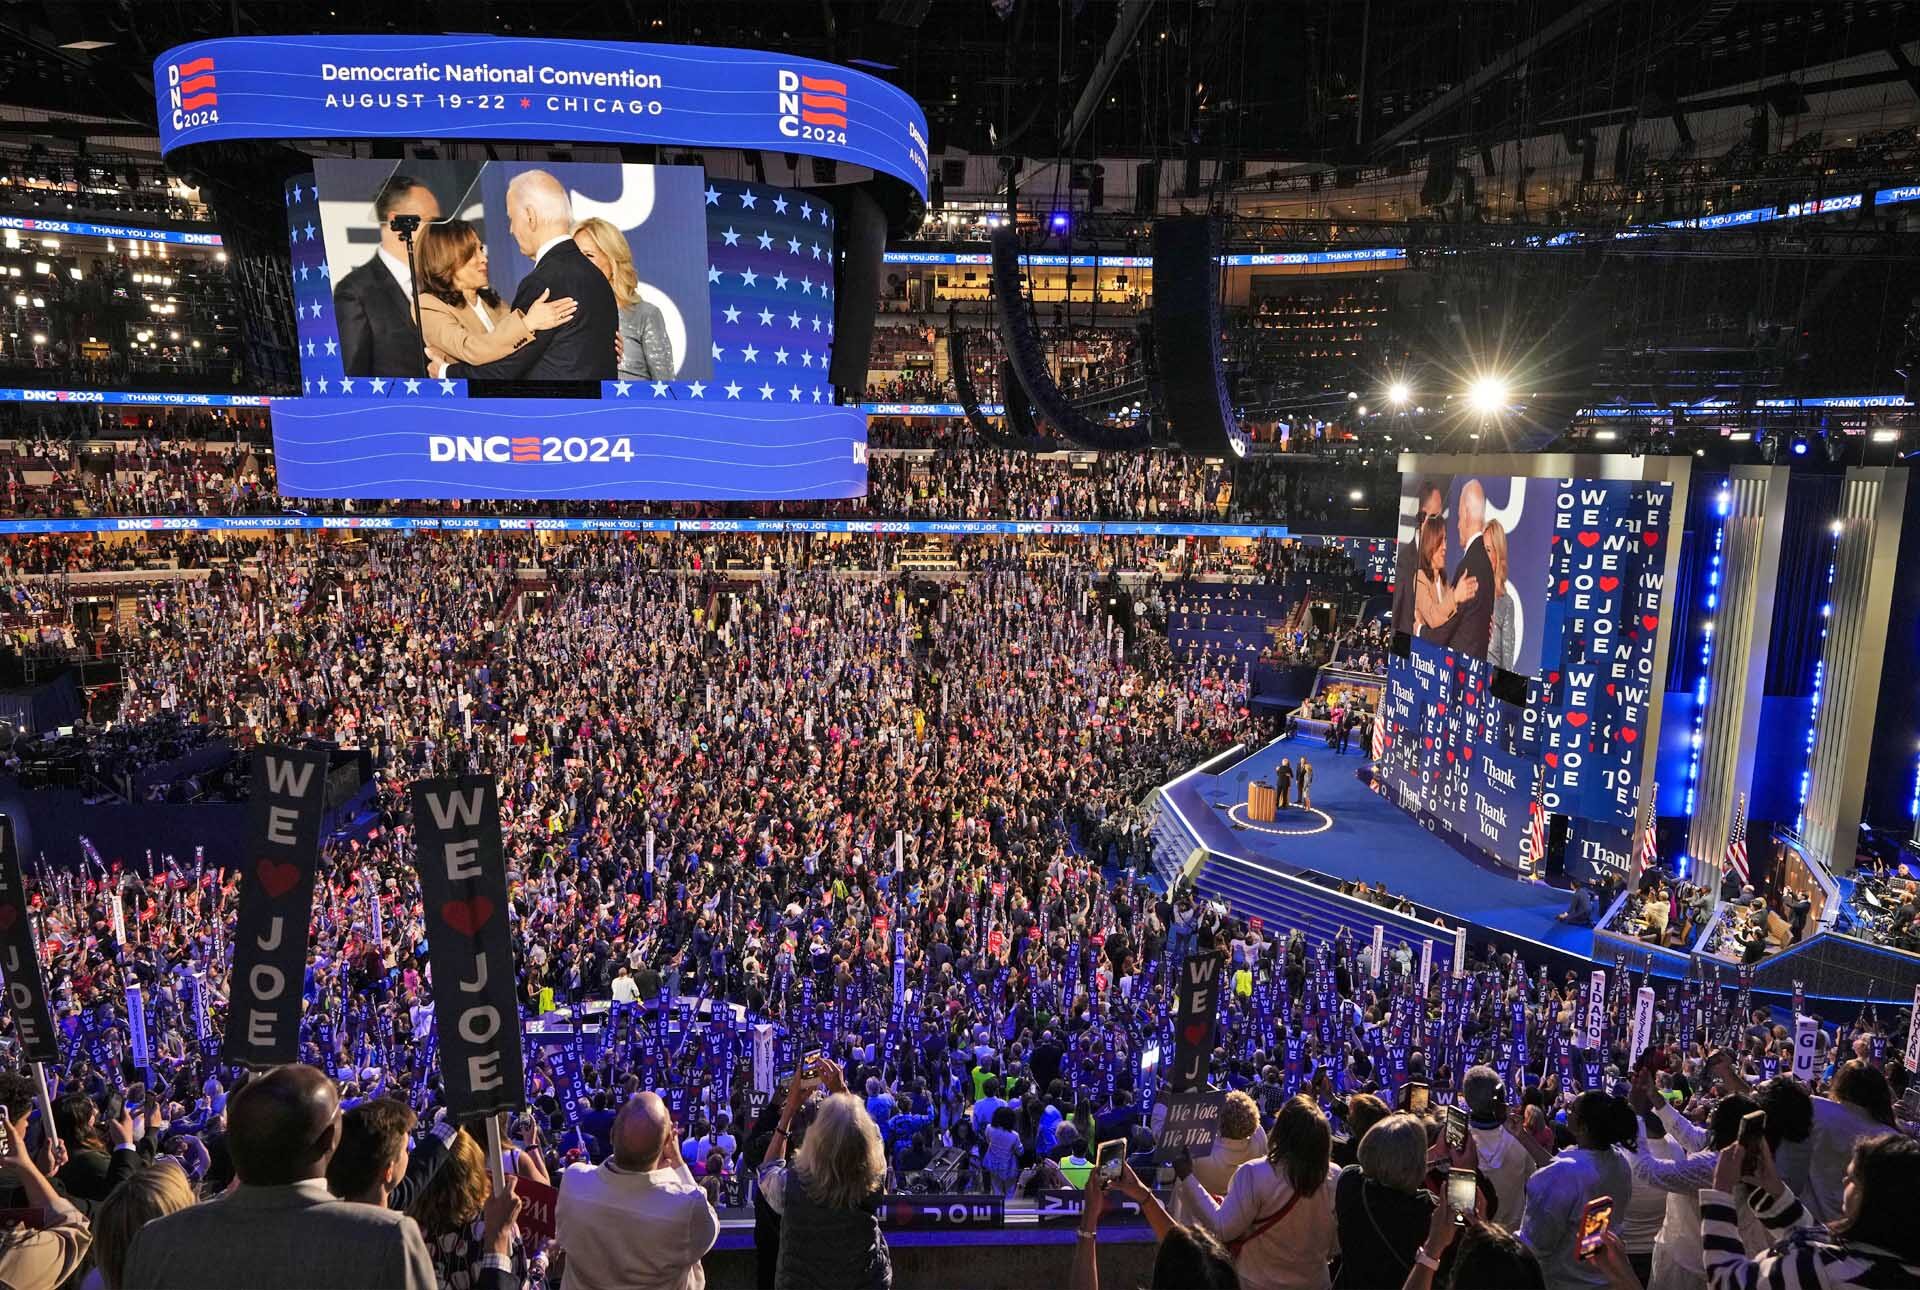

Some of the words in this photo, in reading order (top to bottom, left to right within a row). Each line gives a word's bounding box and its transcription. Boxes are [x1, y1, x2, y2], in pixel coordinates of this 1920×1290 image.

[322, 63, 440, 82] Democratic
[446, 65, 533, 84] National
[539, 67, 661, 88] Convention
[326, 93, 425, 109] AUGUST
[438, 94, 504, 110] 19-22
[546, 97, 663, 114] CHICAGO
[184, 110, 219, 128] 2024
[802, 126, 847, 145] 2024
[35, 221, 69, 232] 2024
[92, 227, 125, 236] THANK
[127, 229, 146, 237] YOU
[149, 231, 166, 239] JOE
[1283, 254, 1308, 263] 2024
[1327, 252, 1352, 260] THANK
[1371, 250, 1386, 258] JOE
[68, 391, 104, 401] 2024
[128, 394, 162, 402] THANK
[163, 395, 184, 403] YOU
[186, 396, 205, 404] JOE
[910, 406, 935, 414] 2024
[1824, 399, 1861, 408] THANK
[1863, 397, 1887, 407] YOU
[429, 436, 510, 462] DNC
[543, 436, 634, 462] 2024
[1580, 489, 1607, 526] WE
[1646, 490, 1664, 526] WE
[163, 519, 198, 529] 2024
[360, 519, 389, 528] 2024
[442, 519, 461, 527] YOU
[463, 519, 479, 527] JOE
[536, 520, 565, 529] 2024
[588, 520, 616, 528] THANK
[710, 521, 738, 530] 2024
[810, 522, 827, 530] JOE
[881, 523, 909, 531] 2024
[933, 523, 957, 531] THANK
[1602, 535, 1626, 570] WE
[1574, 554, 1593, 610] JOE
[1645, 573, 1663, 610] WE
[1593, 599, 1612, 654] JOE
[1410, 651, 1437, 676] Thank
[1391, 679, 1415, 704] Thank
[1568, 672, 1594, 707] WE
[1522, 690, 1538, 741] JOE
[1624, 686, 1643, 723] WE
[1482, 755, 1516, 789] Thank
[1563, 734, 1582, 787] JOE
[1617, 750, 1631, 805] JOE
[264, 755, 315, 845] WE
[1474, 792, 1507, 828] Thank
[1479, 814, 1498, 842] You
[425, 788, 485, 881] WE
[457, 952, 505, 1092] JOE
[248, 917, 284, 1046] JOE
[1189, 957, 1216, 1013] WE
[7, 945, 41, 1044] JOE
[199, 982, 213, 1040] NEVADA
[1589, 983, 1603, 1038] IDAHO
[644, 1038, 656, 1055] WE
[710, 1034, 721, 1054] WE
[884, 1033, 895, 1058] JOE
[1287, 1039, 1300, 1060] WE
[1558, 1038, 1570, 1056] WE
[1681, 1025, 1689, 1049] JOE
[1162, 1044, 1172, 1065] WE
[1392, 1048, 1405, 1070] WE
[563, 1043, 575, 1061] WE
[572, 1072, 583, 1097] JOE
[1106, 1063, 1115, 1091] JOE
[1585, 1064, 1600, 1087] WE
[549, 1053, 566, 1076] WE
[563, 1089, 579, 1121] JOE
[671, 1089, 684, 1110] WE
[748, 1093, 765, 1118] WE
[1170, 1104, 1190, 1122] We
[1162, 1132, 1182, 1148] We
[923, 1203, 991, 1223] JOE
